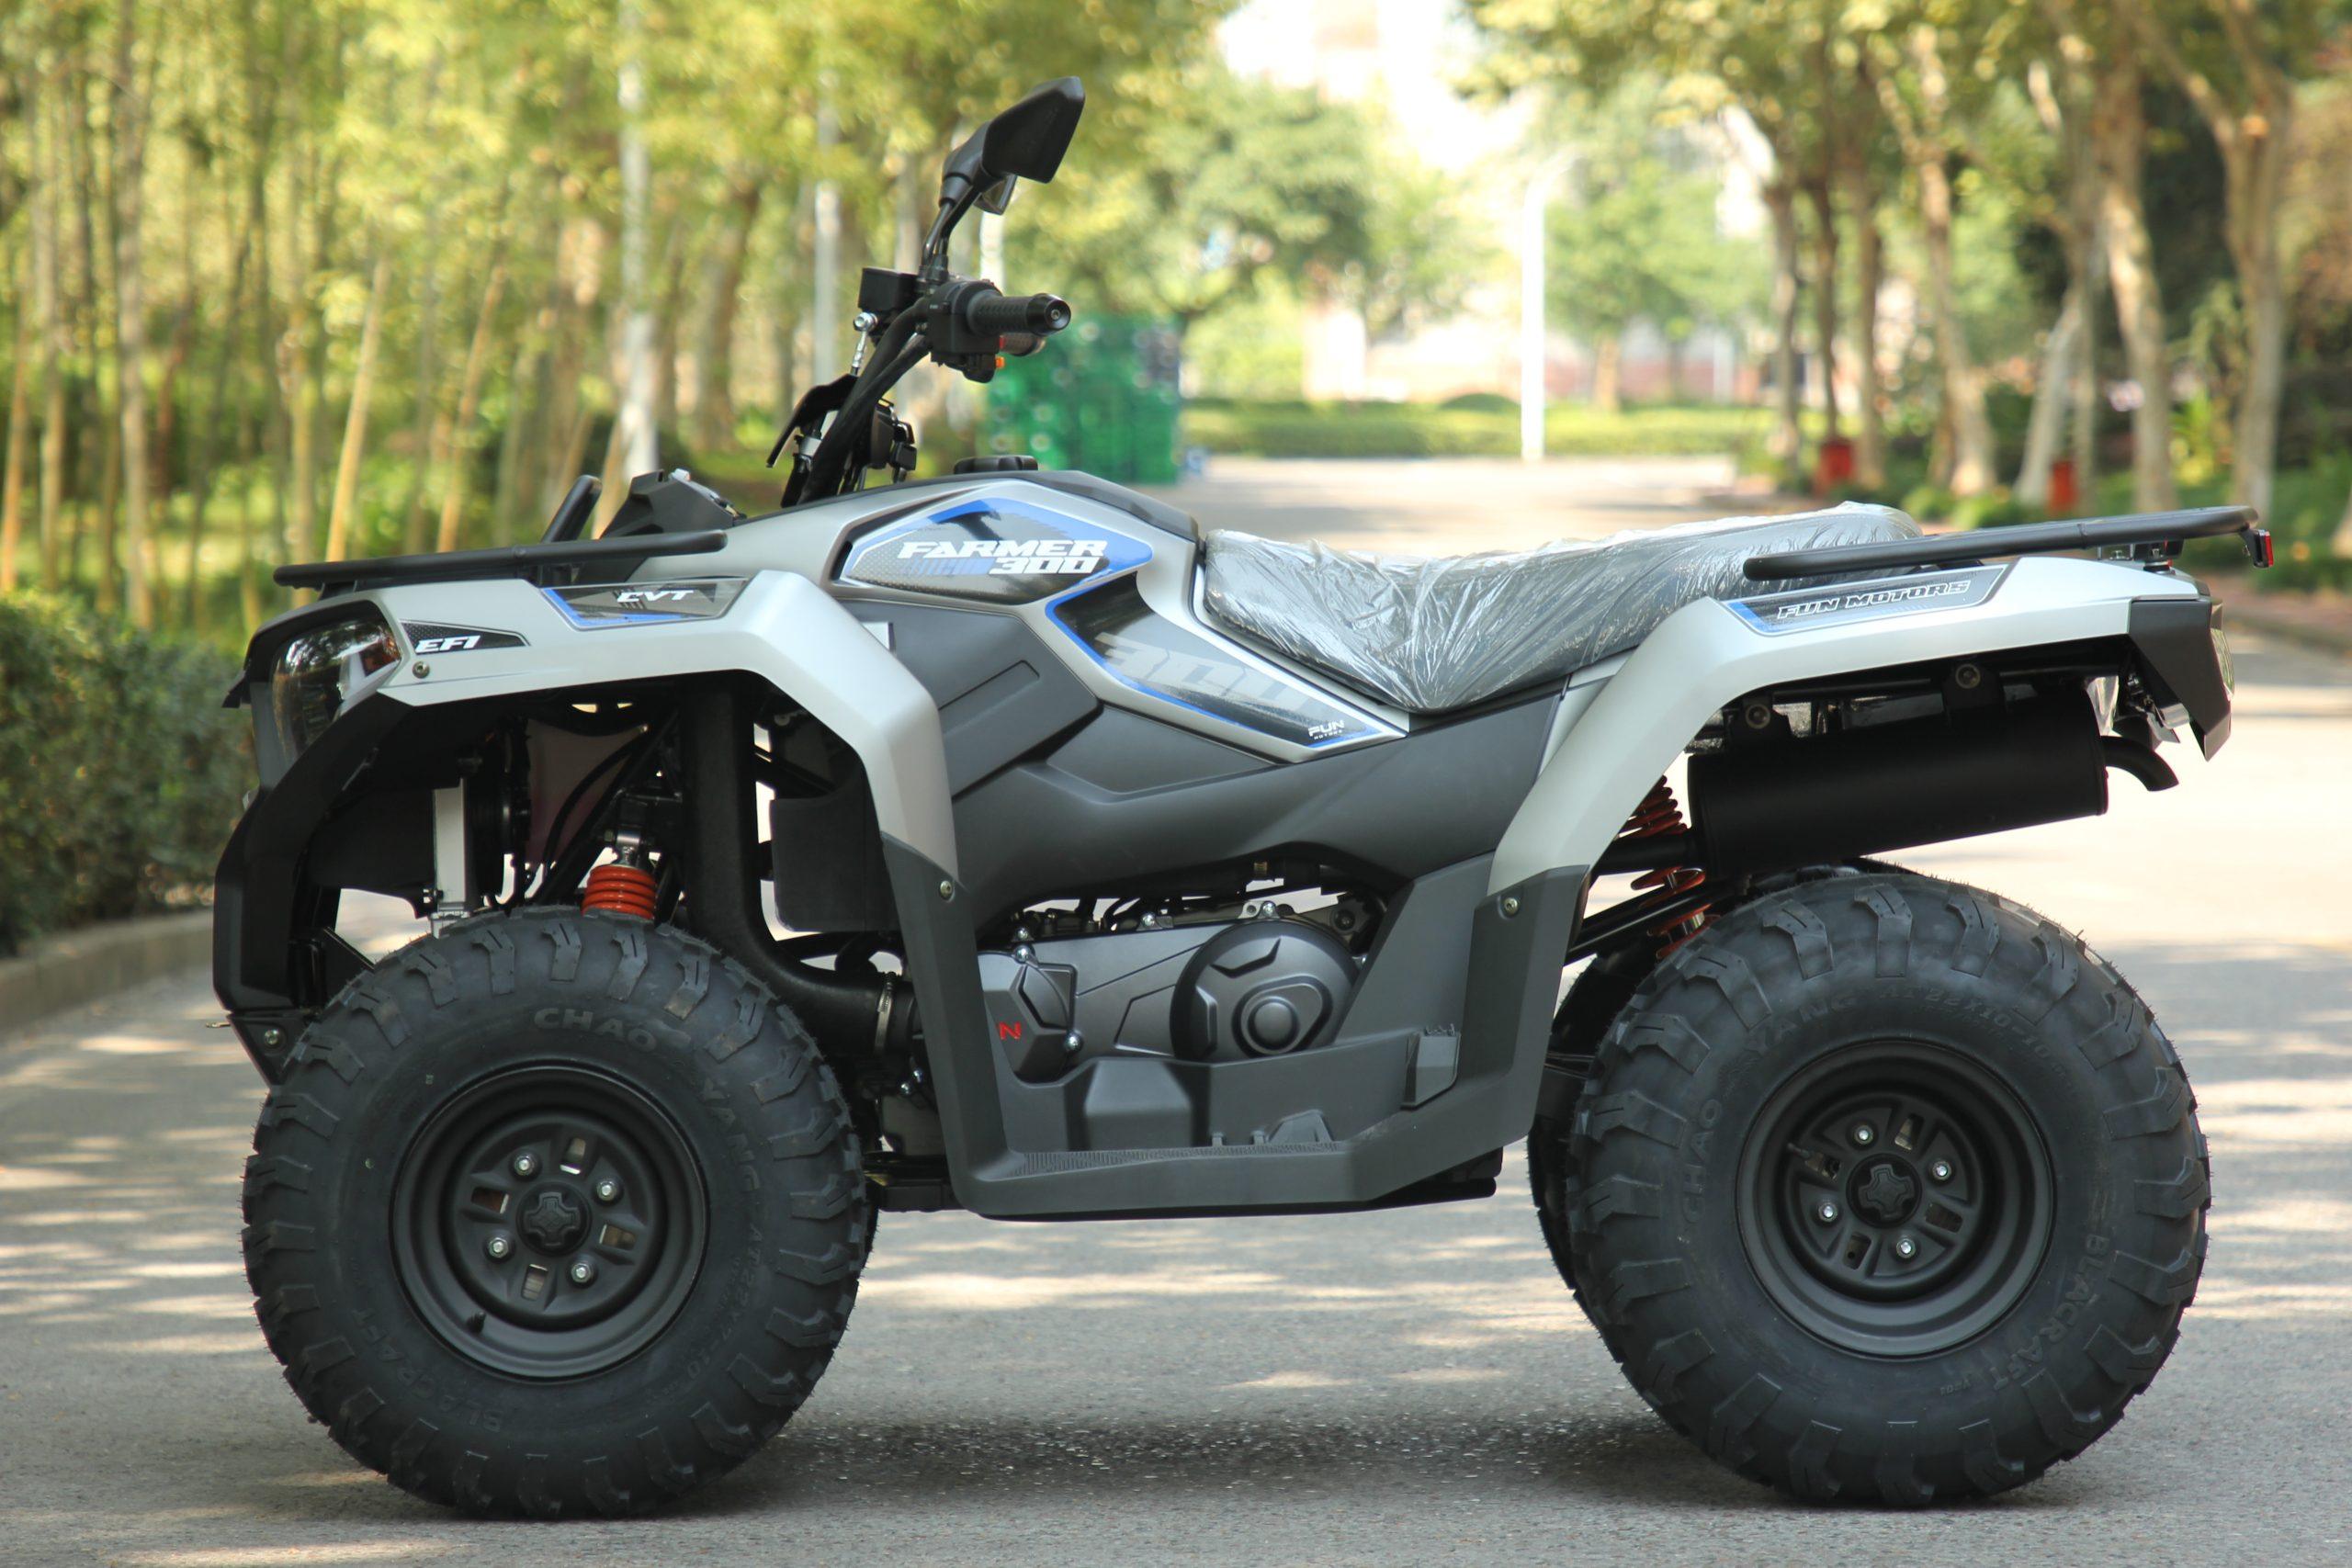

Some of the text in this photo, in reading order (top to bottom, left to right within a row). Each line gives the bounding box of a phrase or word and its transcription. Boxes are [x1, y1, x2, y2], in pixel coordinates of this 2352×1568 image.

[897, 539, 1107, 559] FARMER
[988, 556, 1101, 575] 300
[616, 589, 695, 604] CVT
[1776, 580, 1972, 620] FUN MOTORS
[414, 634, 481, 655] EFI
[1307, 719, 1345, 738] FUN
[534, 1007, 656, 1053] CHAO
[1682, 1098, 1723, 1224] CHAO
